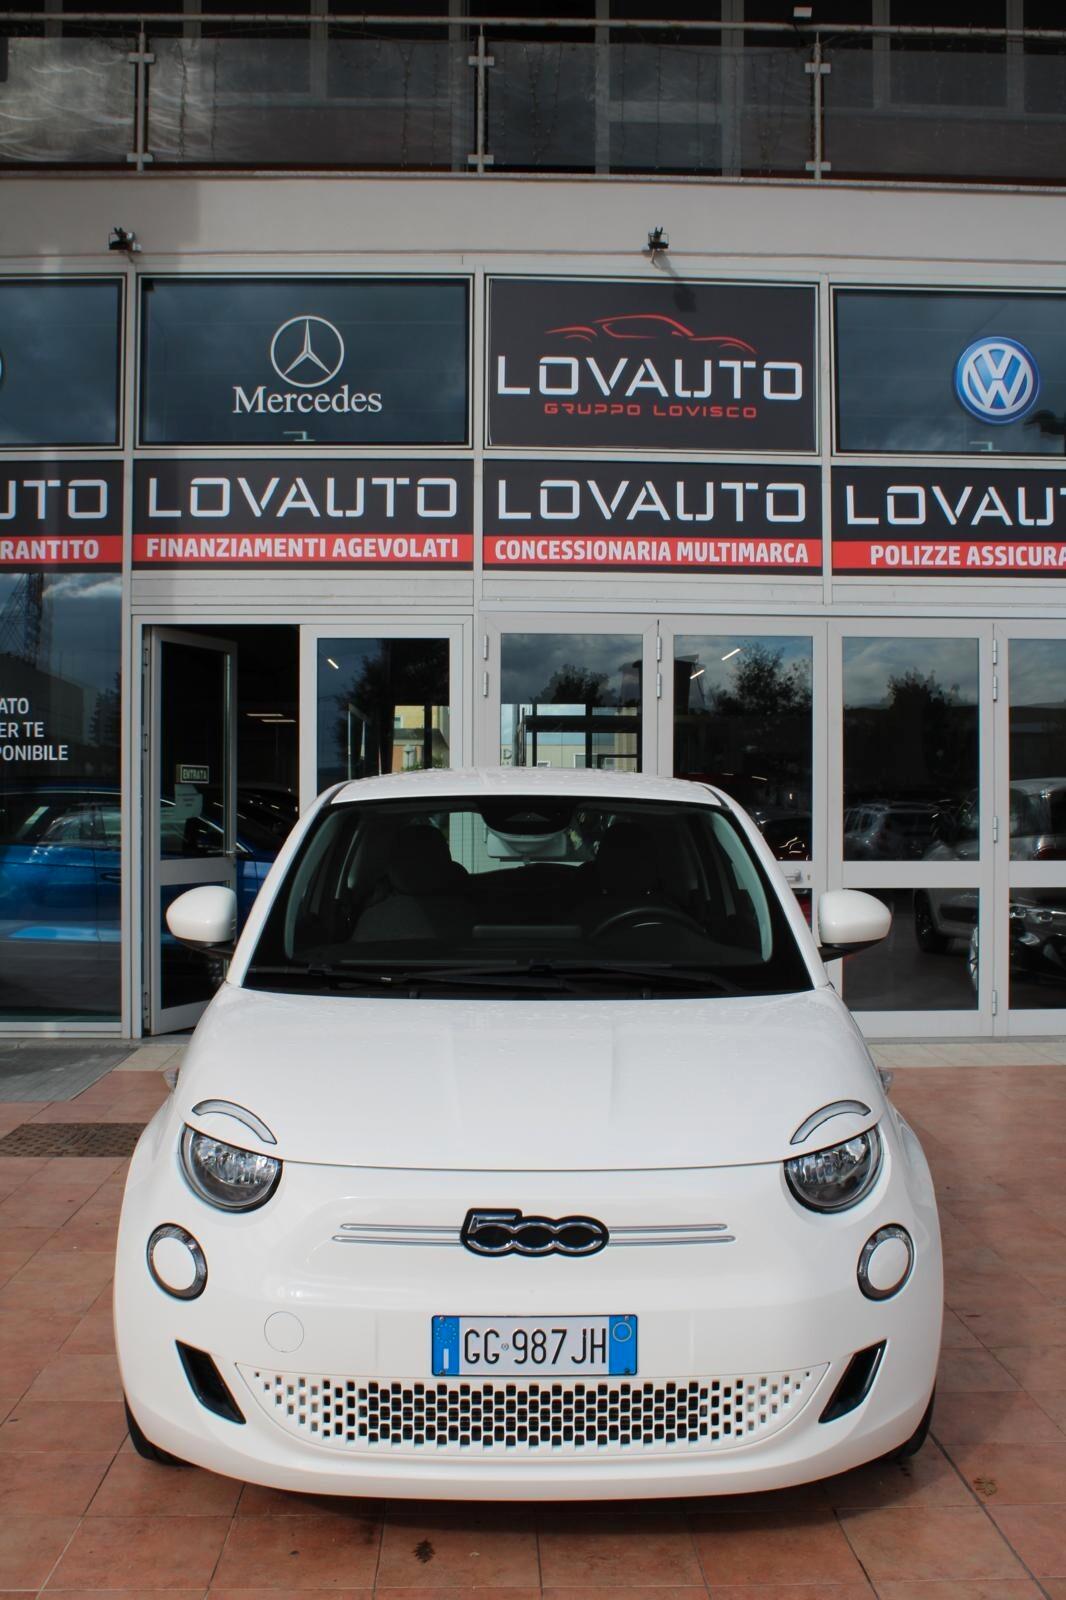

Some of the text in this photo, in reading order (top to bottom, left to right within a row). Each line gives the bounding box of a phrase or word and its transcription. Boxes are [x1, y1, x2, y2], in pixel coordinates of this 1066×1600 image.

[497, 355, 803, 400] LOVAUTO
[233, 385, 383, 414] Mercedes
[544, 403, 757, 419] GRUPPO LOVISCO
[149, 477, 458, 518] LOVAUTO
[498, 479, 806, 522] LOVAUTO
[846, 485, 1066, 526] LOVAU
[0, 539, 99, 560] RANTITO
[146, 537, 458, 559] FINANZIAMENTI AGEVOLATI
[494, 540, 809, 564] CONCESSIONARIA MULTIMARCA
[870, 545, 961, 566] POLIZZE
[23, 721, 45, 738] TE
[0, 744, 69, 761] ONIBILE
[466, 1212, 604, 1253] 500
